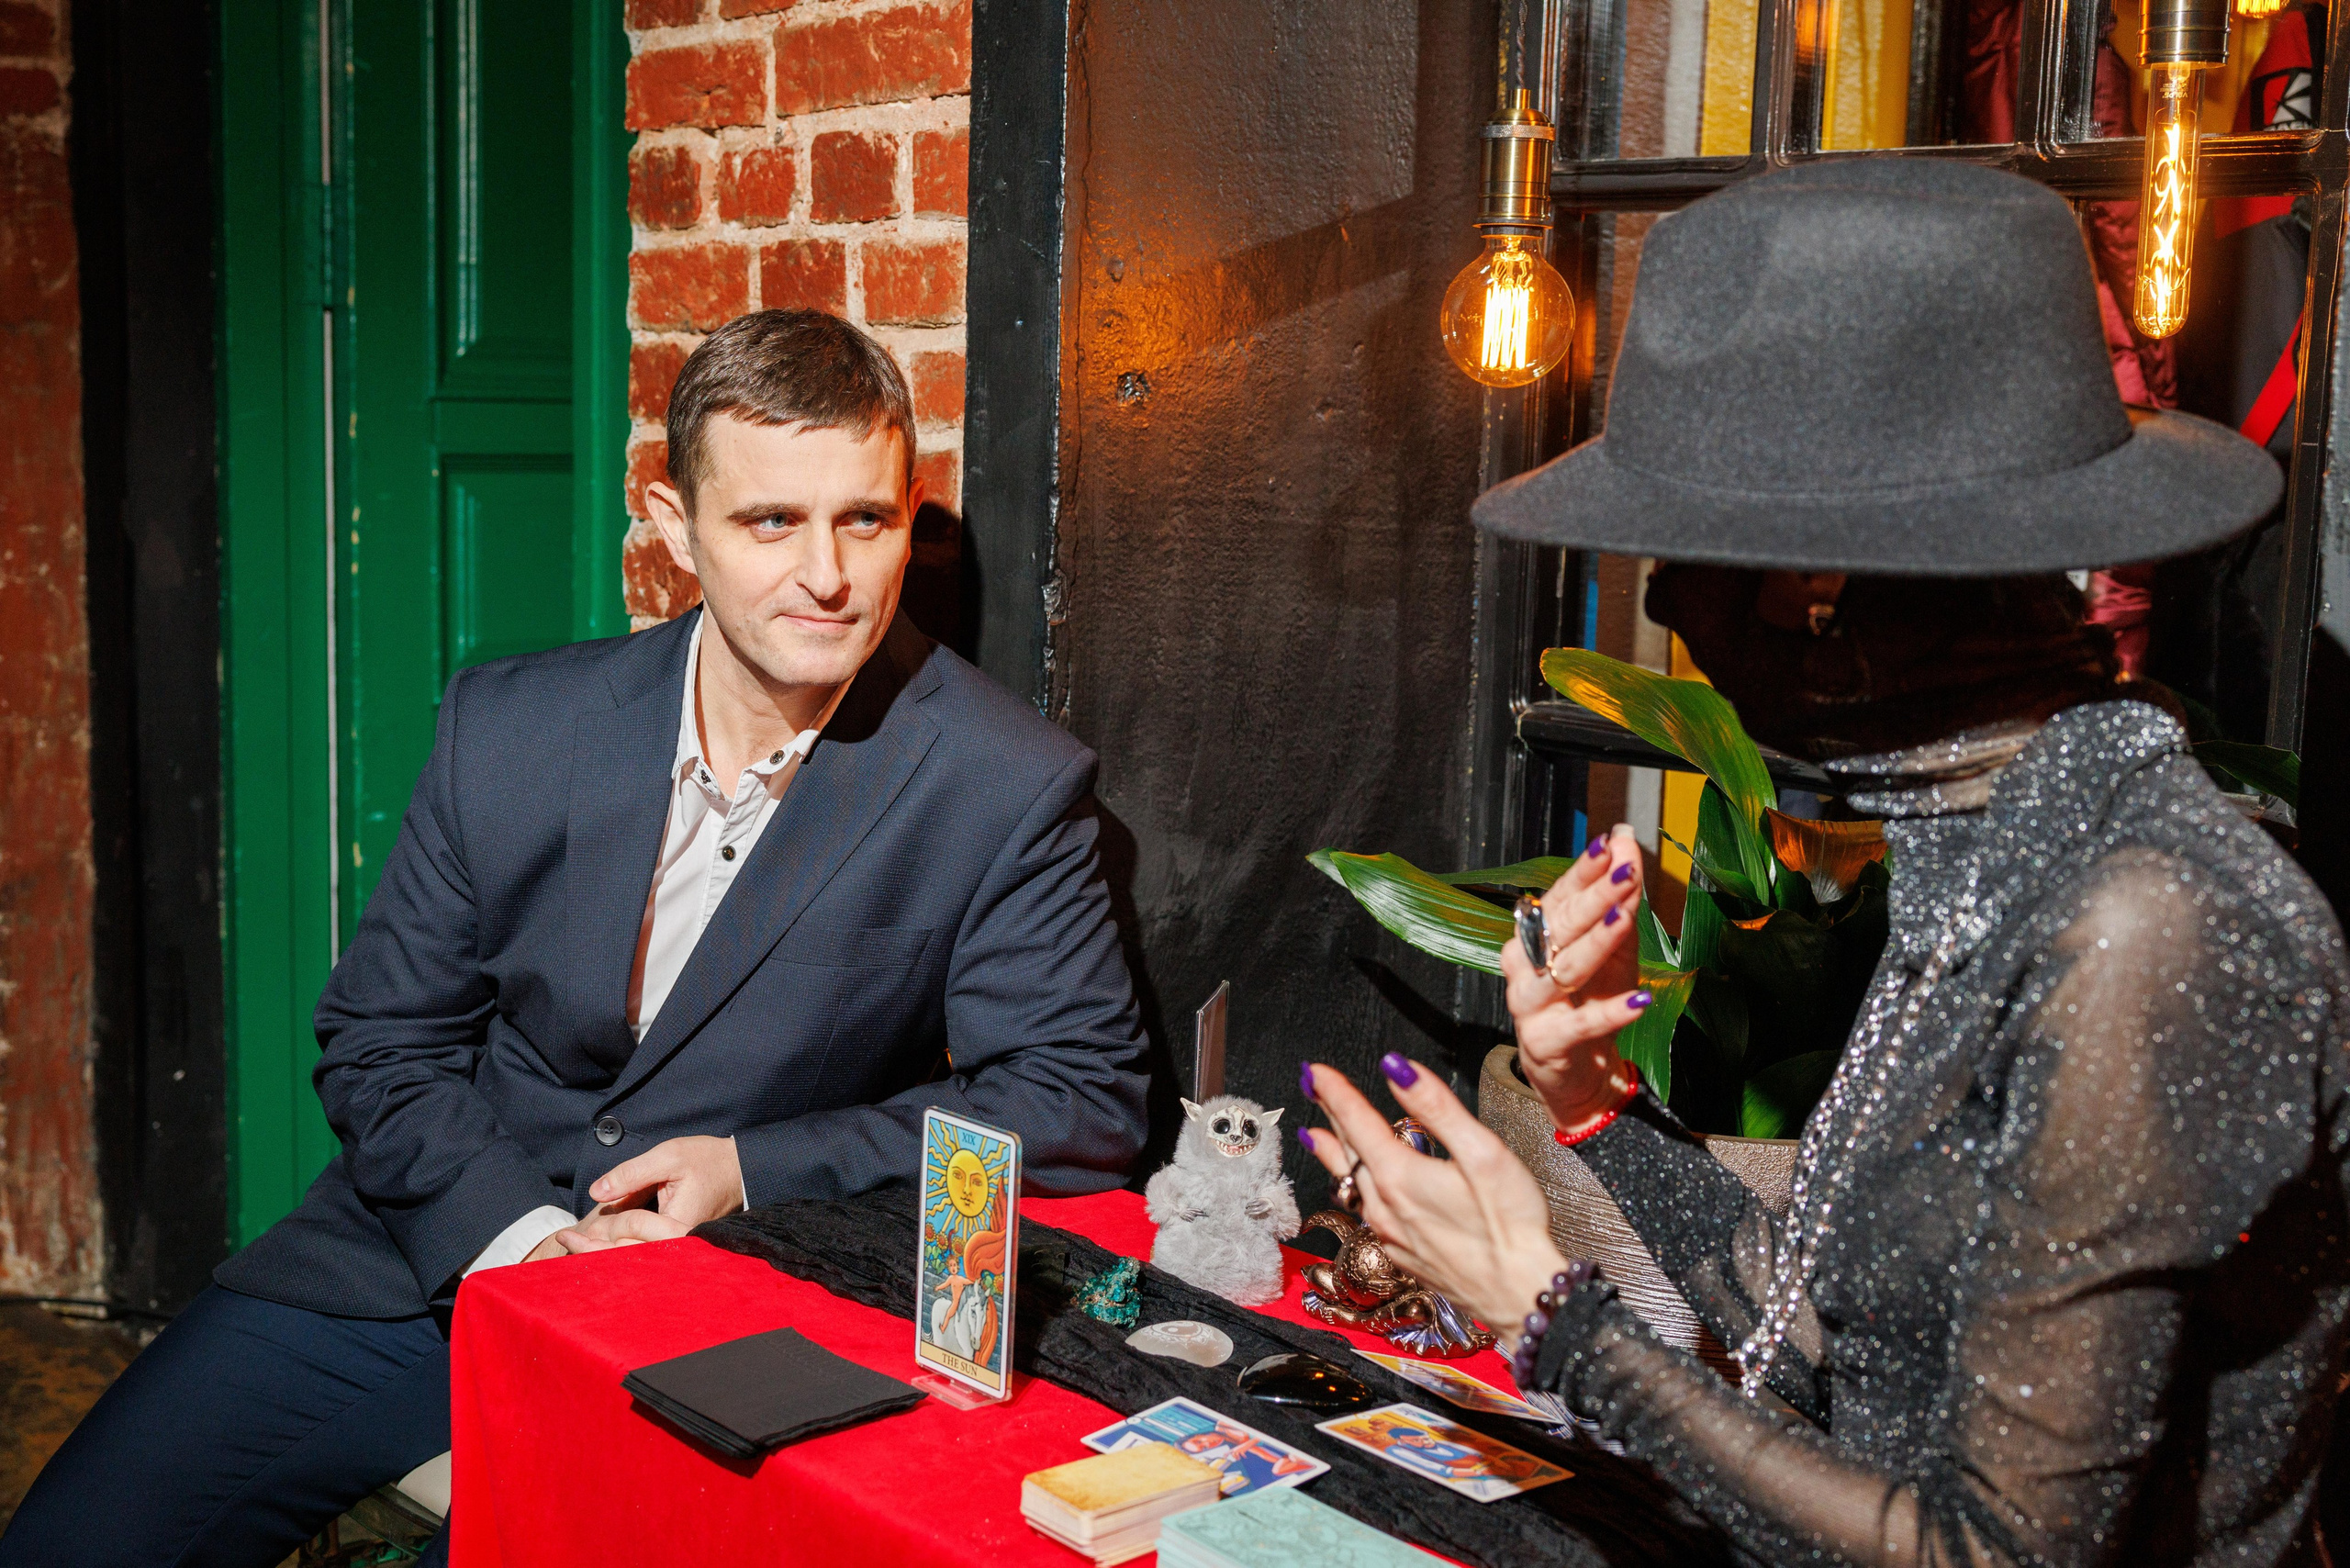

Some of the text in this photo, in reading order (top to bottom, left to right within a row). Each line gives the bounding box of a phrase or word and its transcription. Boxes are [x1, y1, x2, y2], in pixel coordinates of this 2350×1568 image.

[961, 1132, 976, 1146] XIX
[942, 1352, 978, 1376] THE SUN
